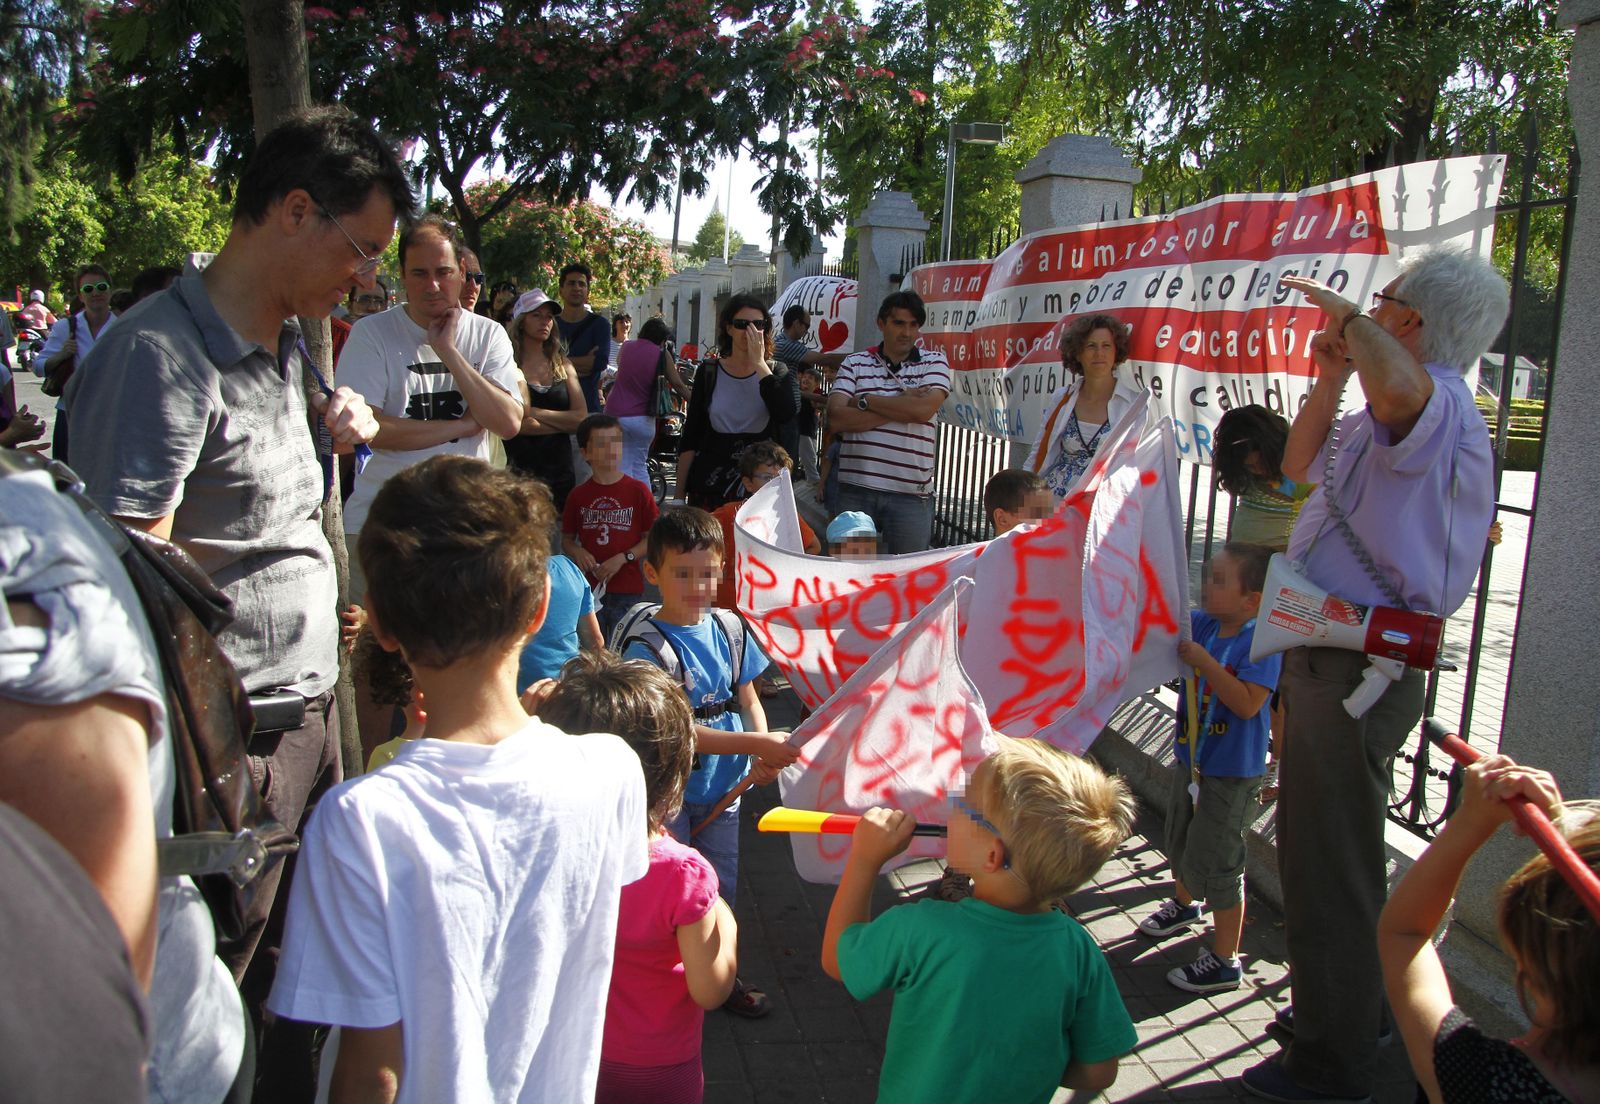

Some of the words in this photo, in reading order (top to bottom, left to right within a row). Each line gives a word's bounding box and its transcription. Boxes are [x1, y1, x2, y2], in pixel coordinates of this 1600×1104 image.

[1272, 203, 1369, 247] aula
[1018, 296, 1028, 322] y
[1202, 260, 1349, 305] colegio
[1022, 366, 1067, 401] públ
[1134, 366, 1162, 399] de
[596, 524, 610, 545] 3
